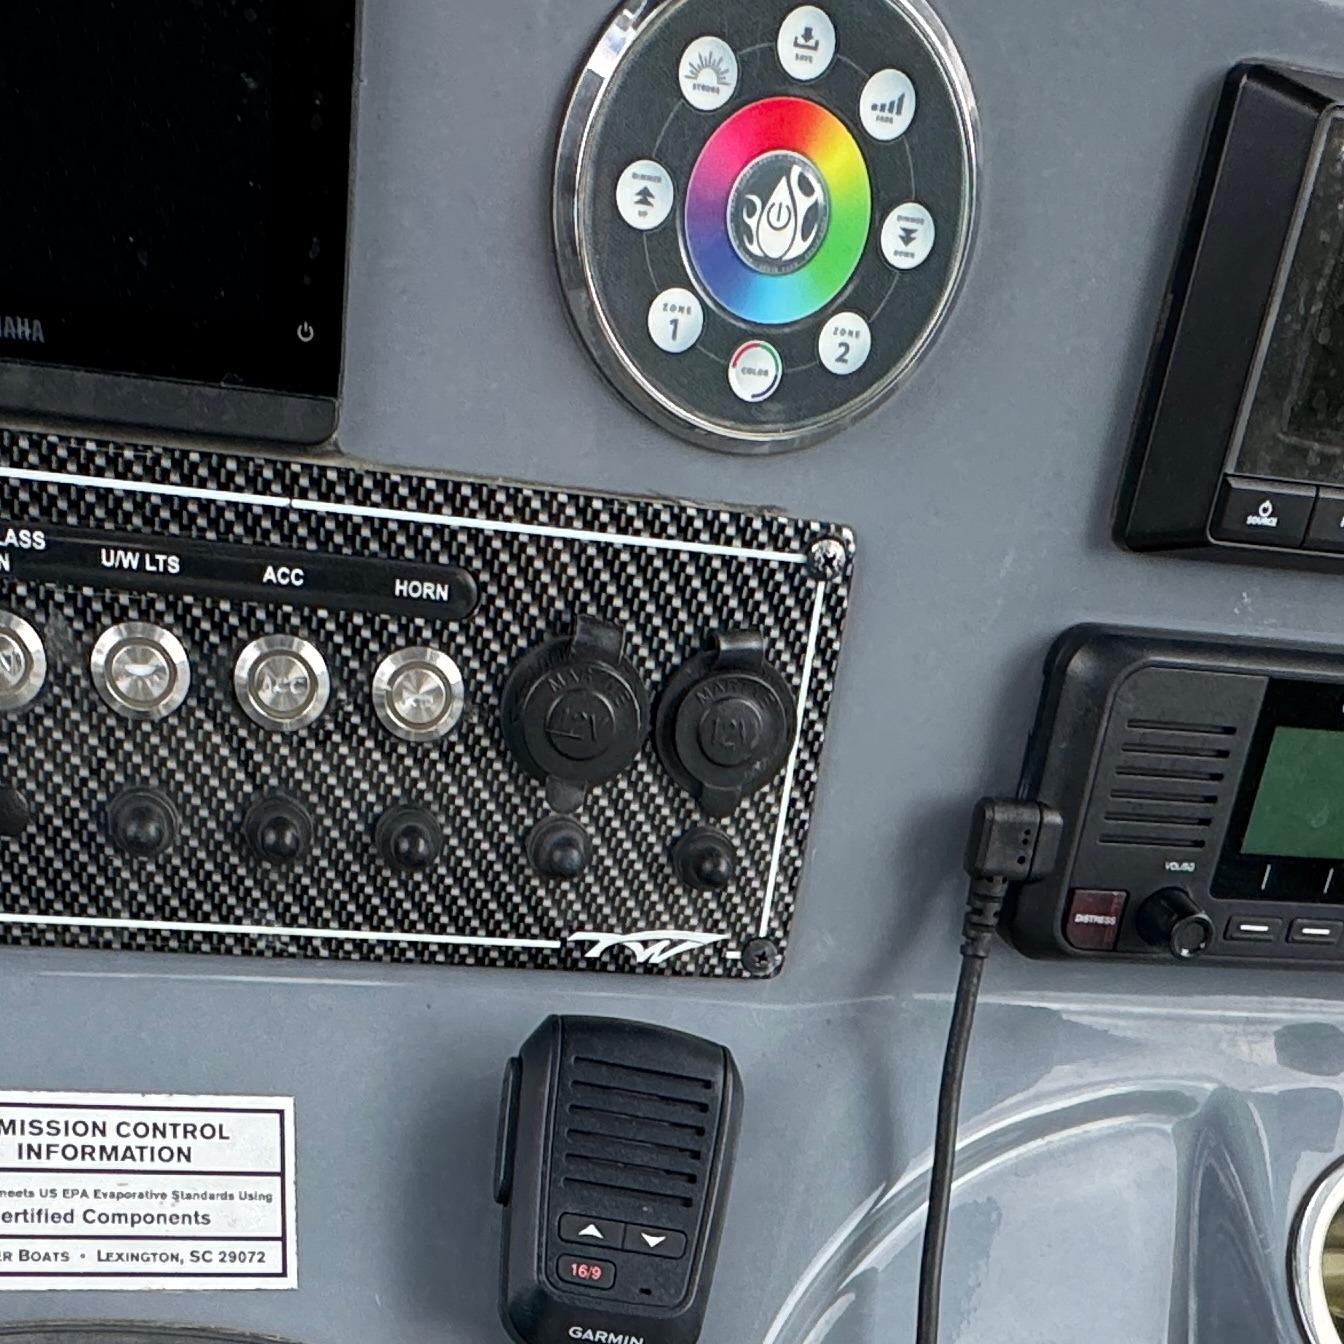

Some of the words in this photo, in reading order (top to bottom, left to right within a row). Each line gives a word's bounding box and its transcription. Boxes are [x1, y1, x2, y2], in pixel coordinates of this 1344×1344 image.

[662, 302, 693, 316] ZONE
[668, 318, 679, 342] 1
[832, 326, 861, 339] ZONE
[834, 341, 851, 365] 2
[100, 547, 141, 571] U/W
[144, 552, 181, 576] LTS
[261, 564, 305, 588] ACC
[393, 577, 450, 601] HORN
[1074, 913, 1117, 926] DISTRESS
[115, 1120, 231, 1141] CONTROL
[17, 1142, 193, 1164] INFORMATION
[38, 1188, 58, 1200] US
[61, 1188, 91, 1201] EPA
[93, 1188, 169, 1203] Evaporative
[171, 1189, 236, 1202] Standards
[238, 1190, 274, 1204] Using
[82, 1208, 212, 1229] Components
[189, 1249, 213, 1264] SC
[217, 1250, 267, 1264] 29072
[571, 1263, 602, 1280] 16/9
